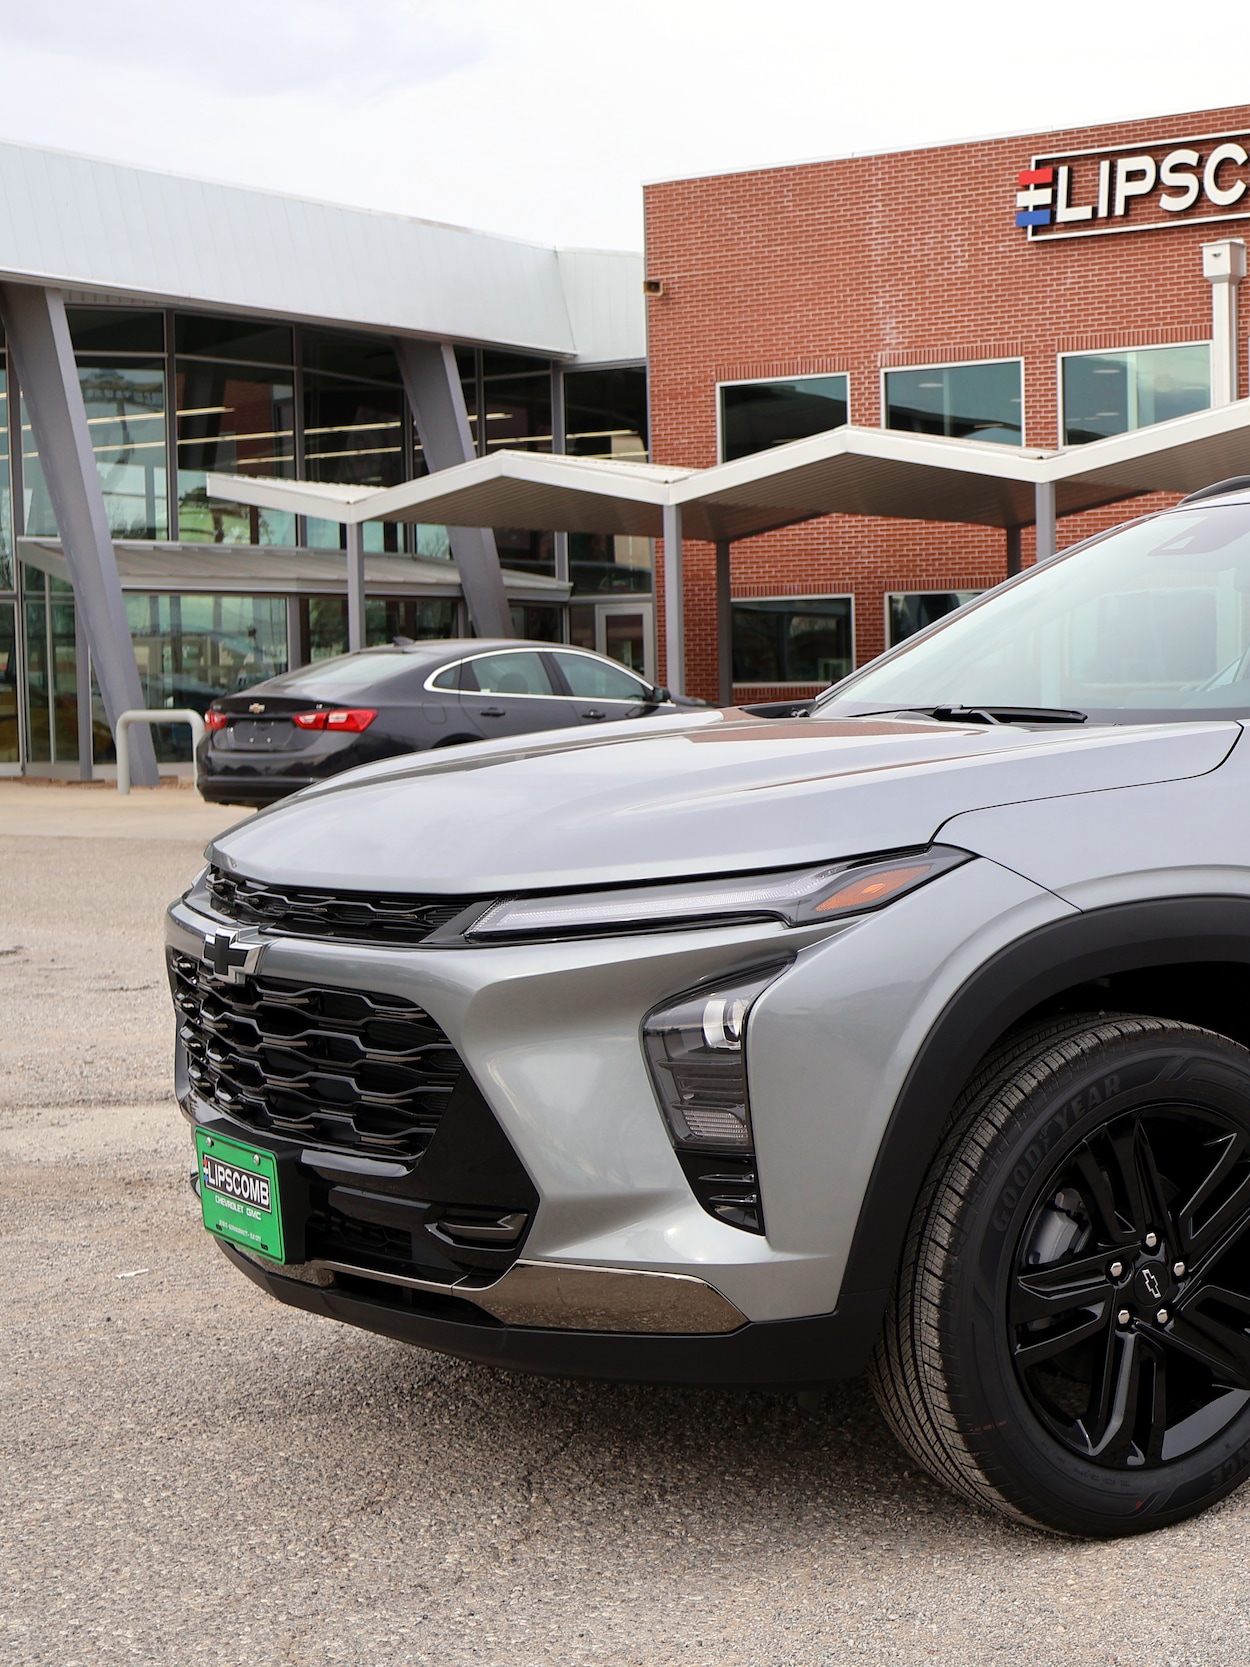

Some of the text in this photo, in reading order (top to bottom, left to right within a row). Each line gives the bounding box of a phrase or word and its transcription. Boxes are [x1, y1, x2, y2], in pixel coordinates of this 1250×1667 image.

[992, 1074, 1121, 1232] GOODYEAR
[208, 1161, 269, 1206] LIPSCOMB
[215, 1195, 262, 1220] CHEVROLET GMC
